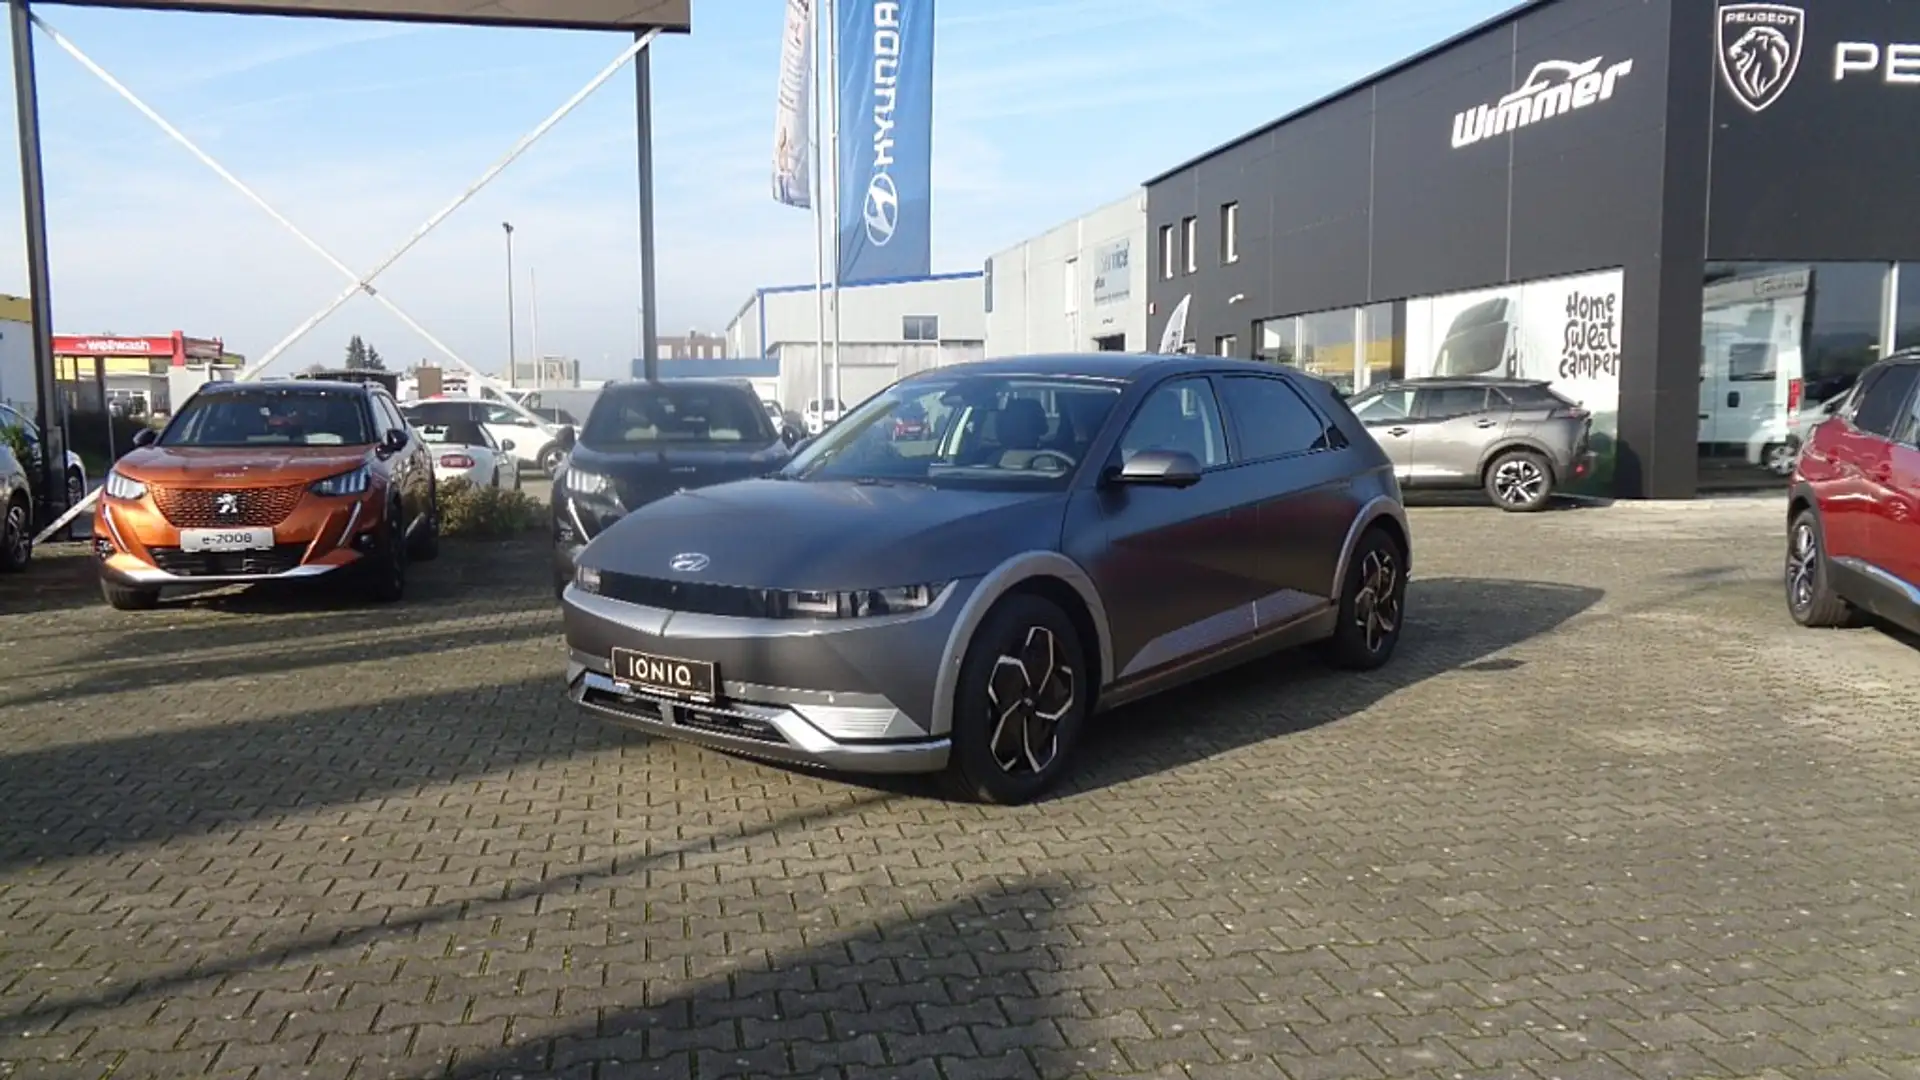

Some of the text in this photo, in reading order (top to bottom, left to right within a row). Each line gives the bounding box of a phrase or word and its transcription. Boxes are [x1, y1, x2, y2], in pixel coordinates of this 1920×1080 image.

[1725, 12, 1796, 24] PEUGEOT
[1452, 57, 1633, 148] Wimmer
[1566, 291, 1616, 321] Home
[202, 533, 252, 544] e-2008
[629, 656, 691, 686] IONIQ
